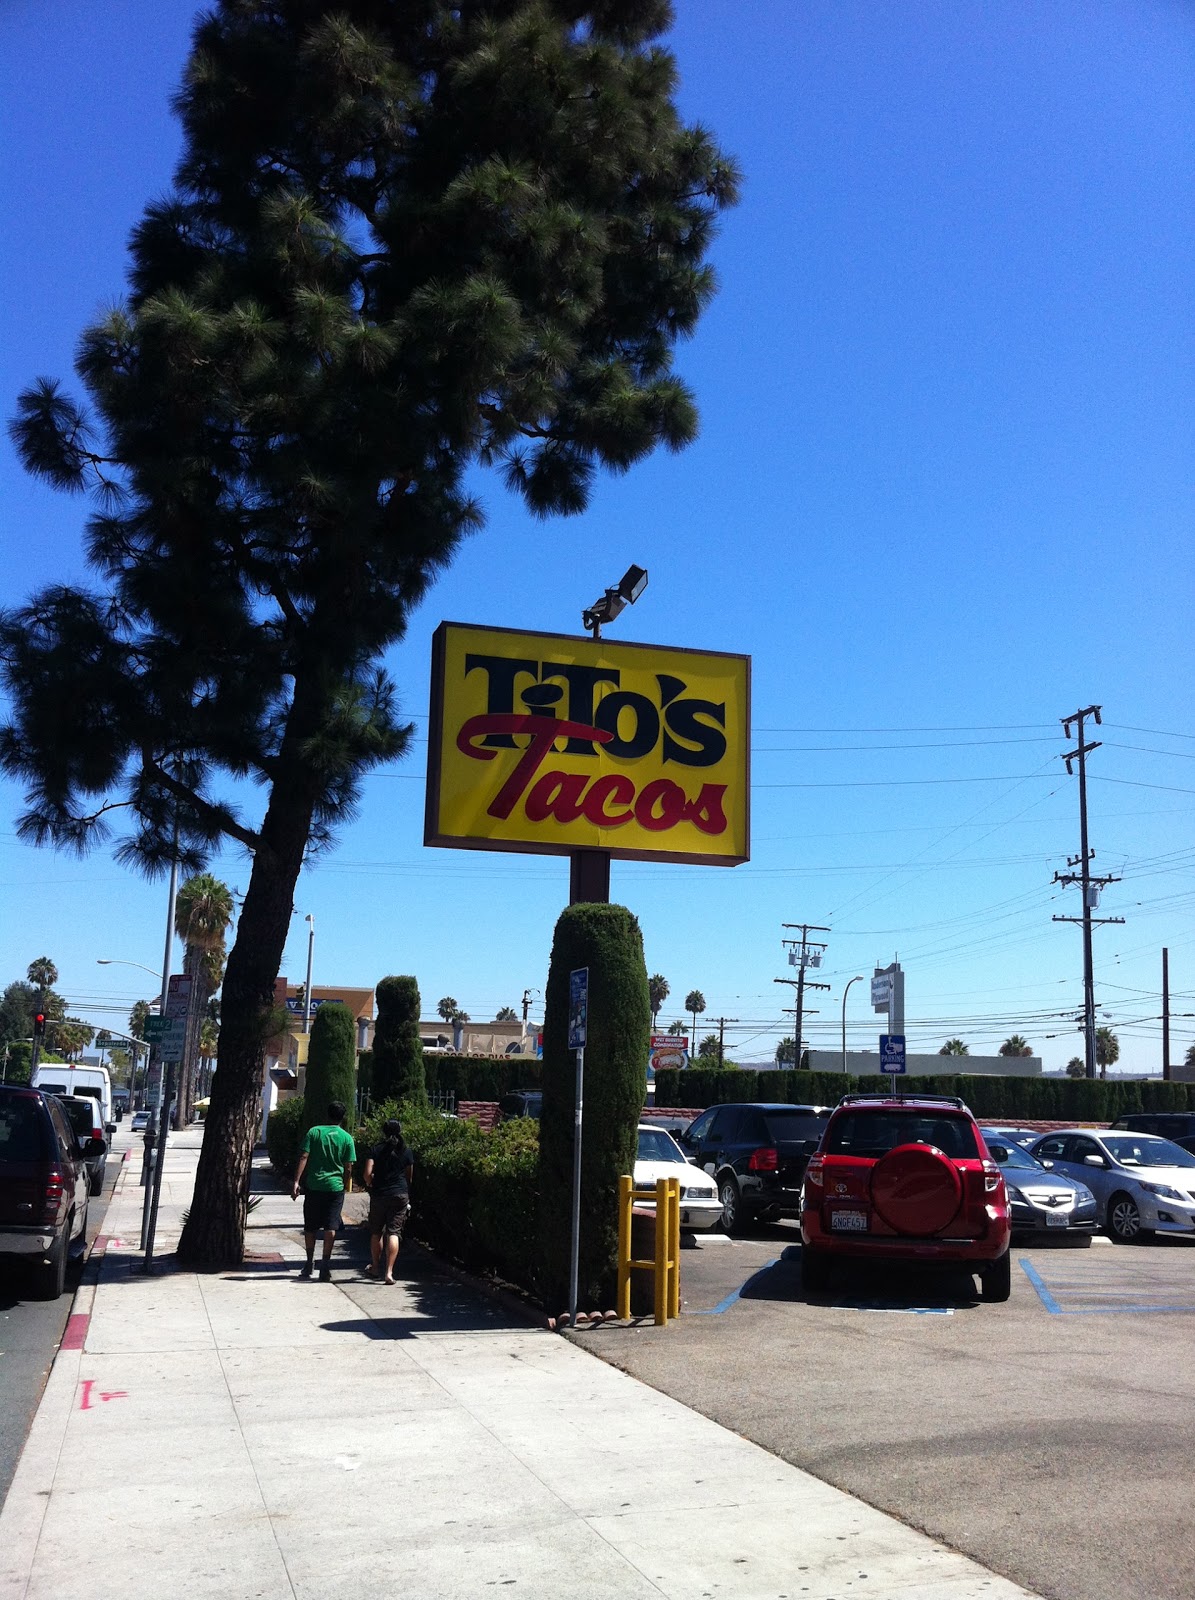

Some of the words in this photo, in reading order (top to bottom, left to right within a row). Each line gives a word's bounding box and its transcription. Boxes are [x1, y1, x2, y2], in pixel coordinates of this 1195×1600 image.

[456, 713, 728, 835] Tacos
[165, 1019, 171, 1030] 2
[881, 1054, 904, 1063] PARKING
